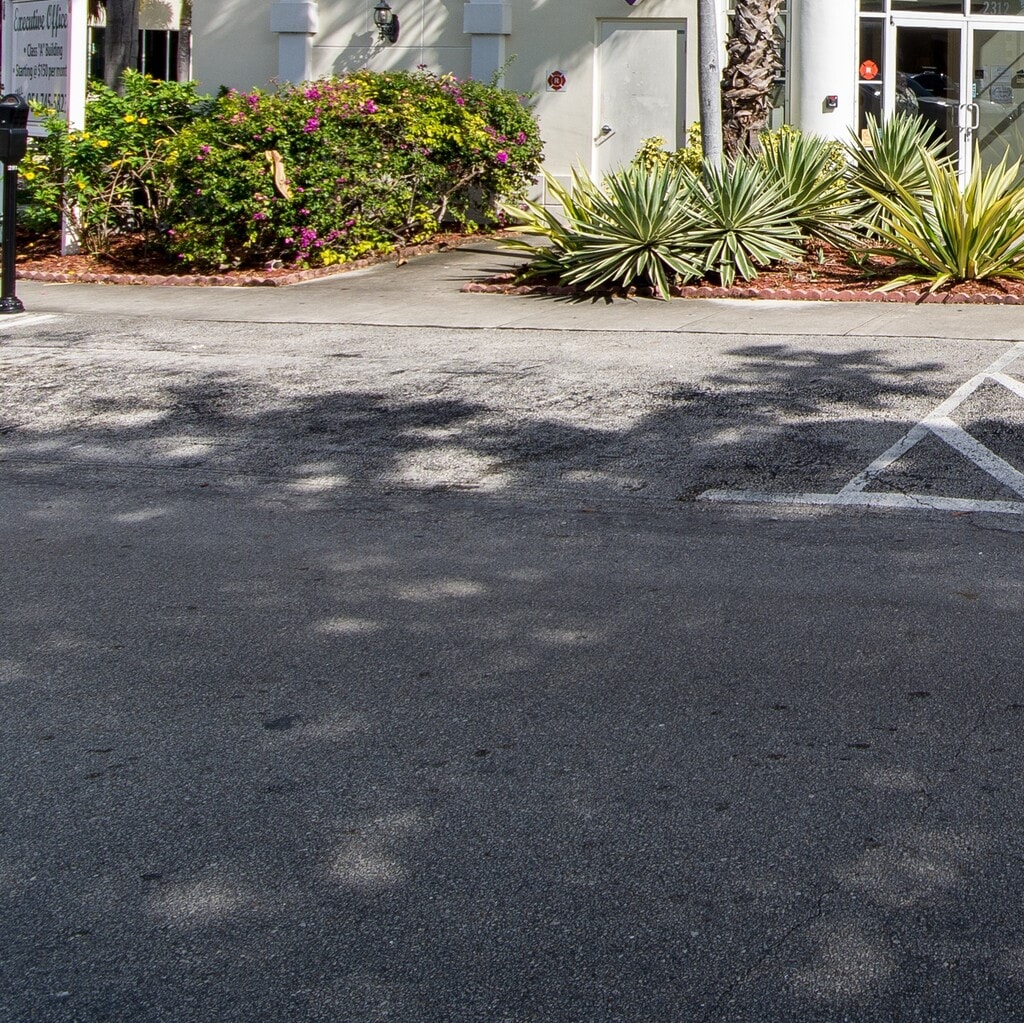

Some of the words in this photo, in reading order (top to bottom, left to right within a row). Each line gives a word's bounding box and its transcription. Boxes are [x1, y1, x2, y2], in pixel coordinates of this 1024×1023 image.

[983, 1, 1010, 14] 2312
[14, 7, 45, 32] Executive
[27, 43, 38, 57] Class
[45, 42, 63, 60] Building
[16, 63, 33, 81] Starting
[48, 66, 56, 81] per
